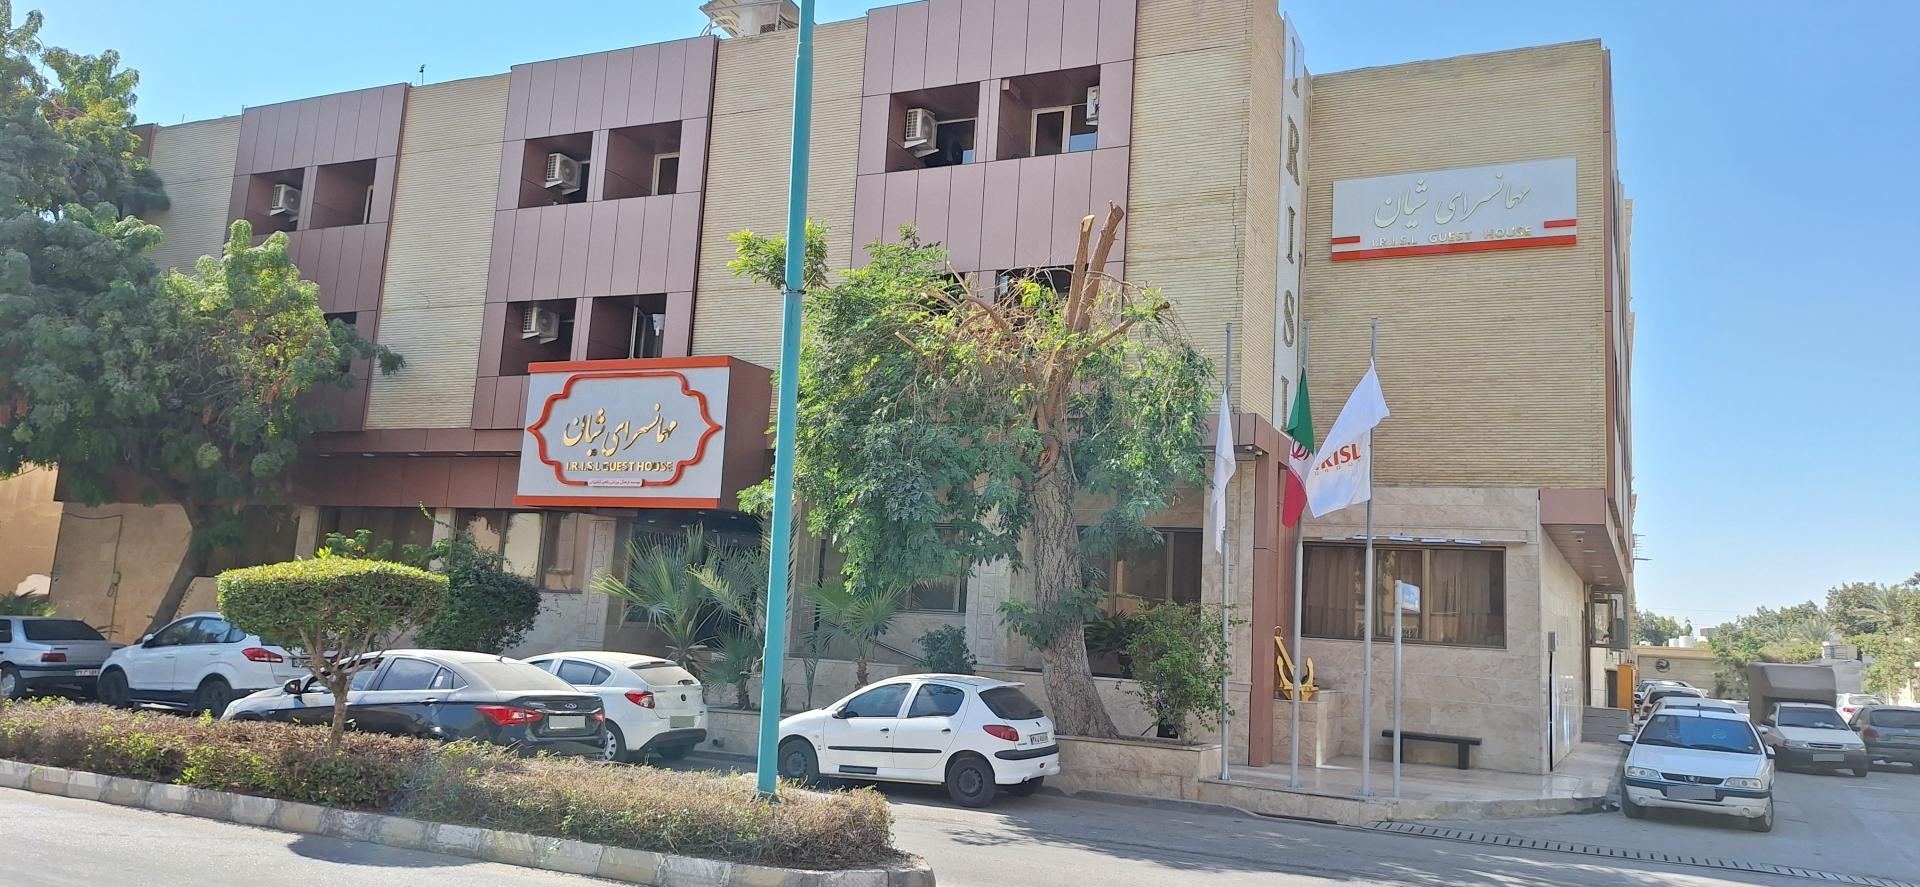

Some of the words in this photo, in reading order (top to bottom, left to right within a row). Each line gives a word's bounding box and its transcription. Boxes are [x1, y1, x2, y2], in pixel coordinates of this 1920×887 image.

[1429, 230, 1473, 244] GUEST
[1483, 226, 1532, 240] HOUSE
[603, 461, 635, 472] GUEST
[637, 461, 673, 472] HOUSE
